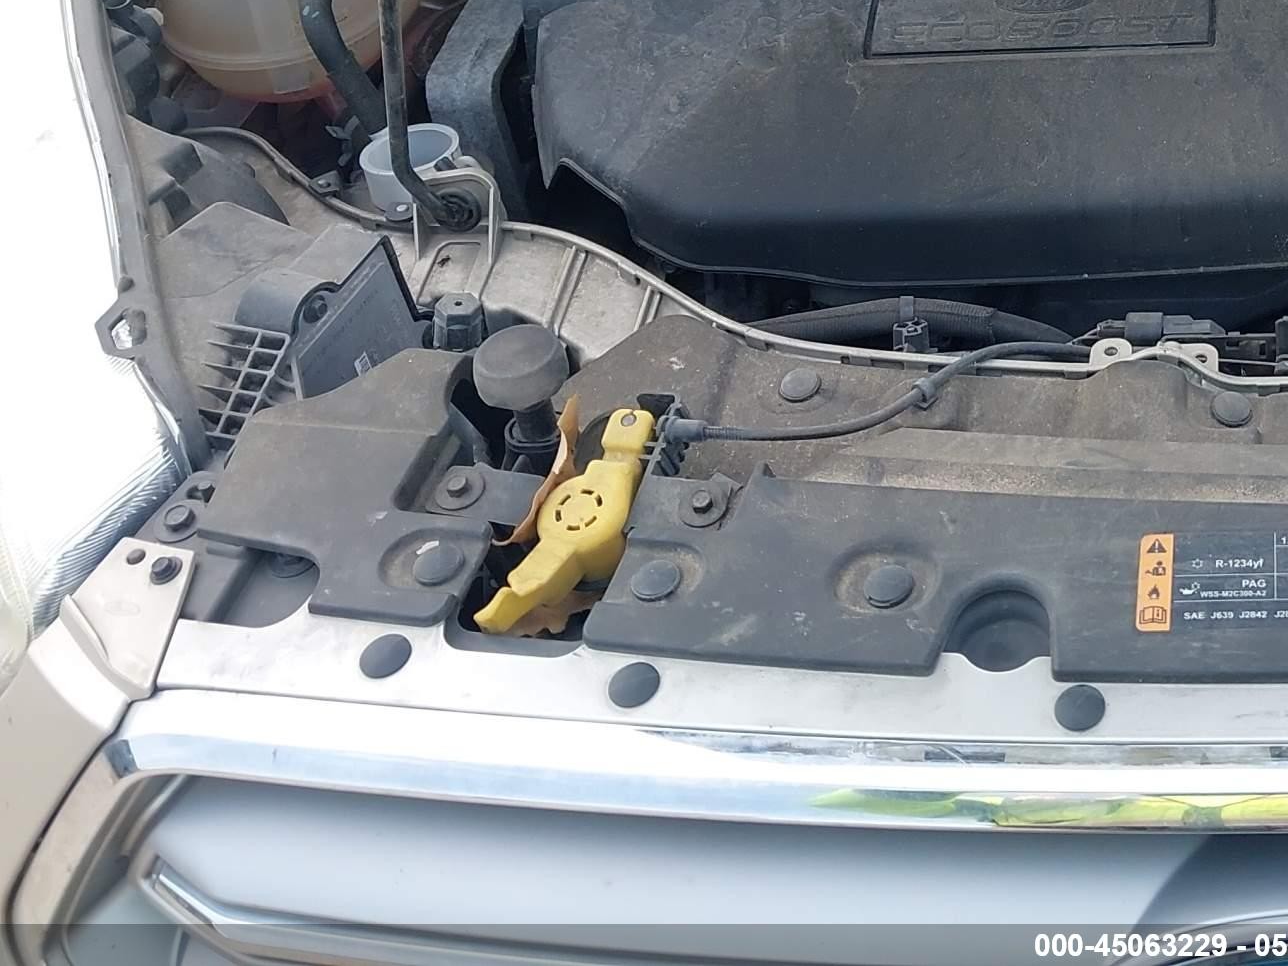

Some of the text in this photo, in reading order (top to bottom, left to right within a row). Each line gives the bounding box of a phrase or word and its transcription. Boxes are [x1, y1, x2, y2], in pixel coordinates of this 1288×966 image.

[1215, 557, 1265, 569] R-1234yf
[1241, 579, 1267, 588] PAG
[1183, 611, 1205, 620] SAE
[1210, 611, 1234, 620] J639
[1238, 610, 1268, 619] J2842
